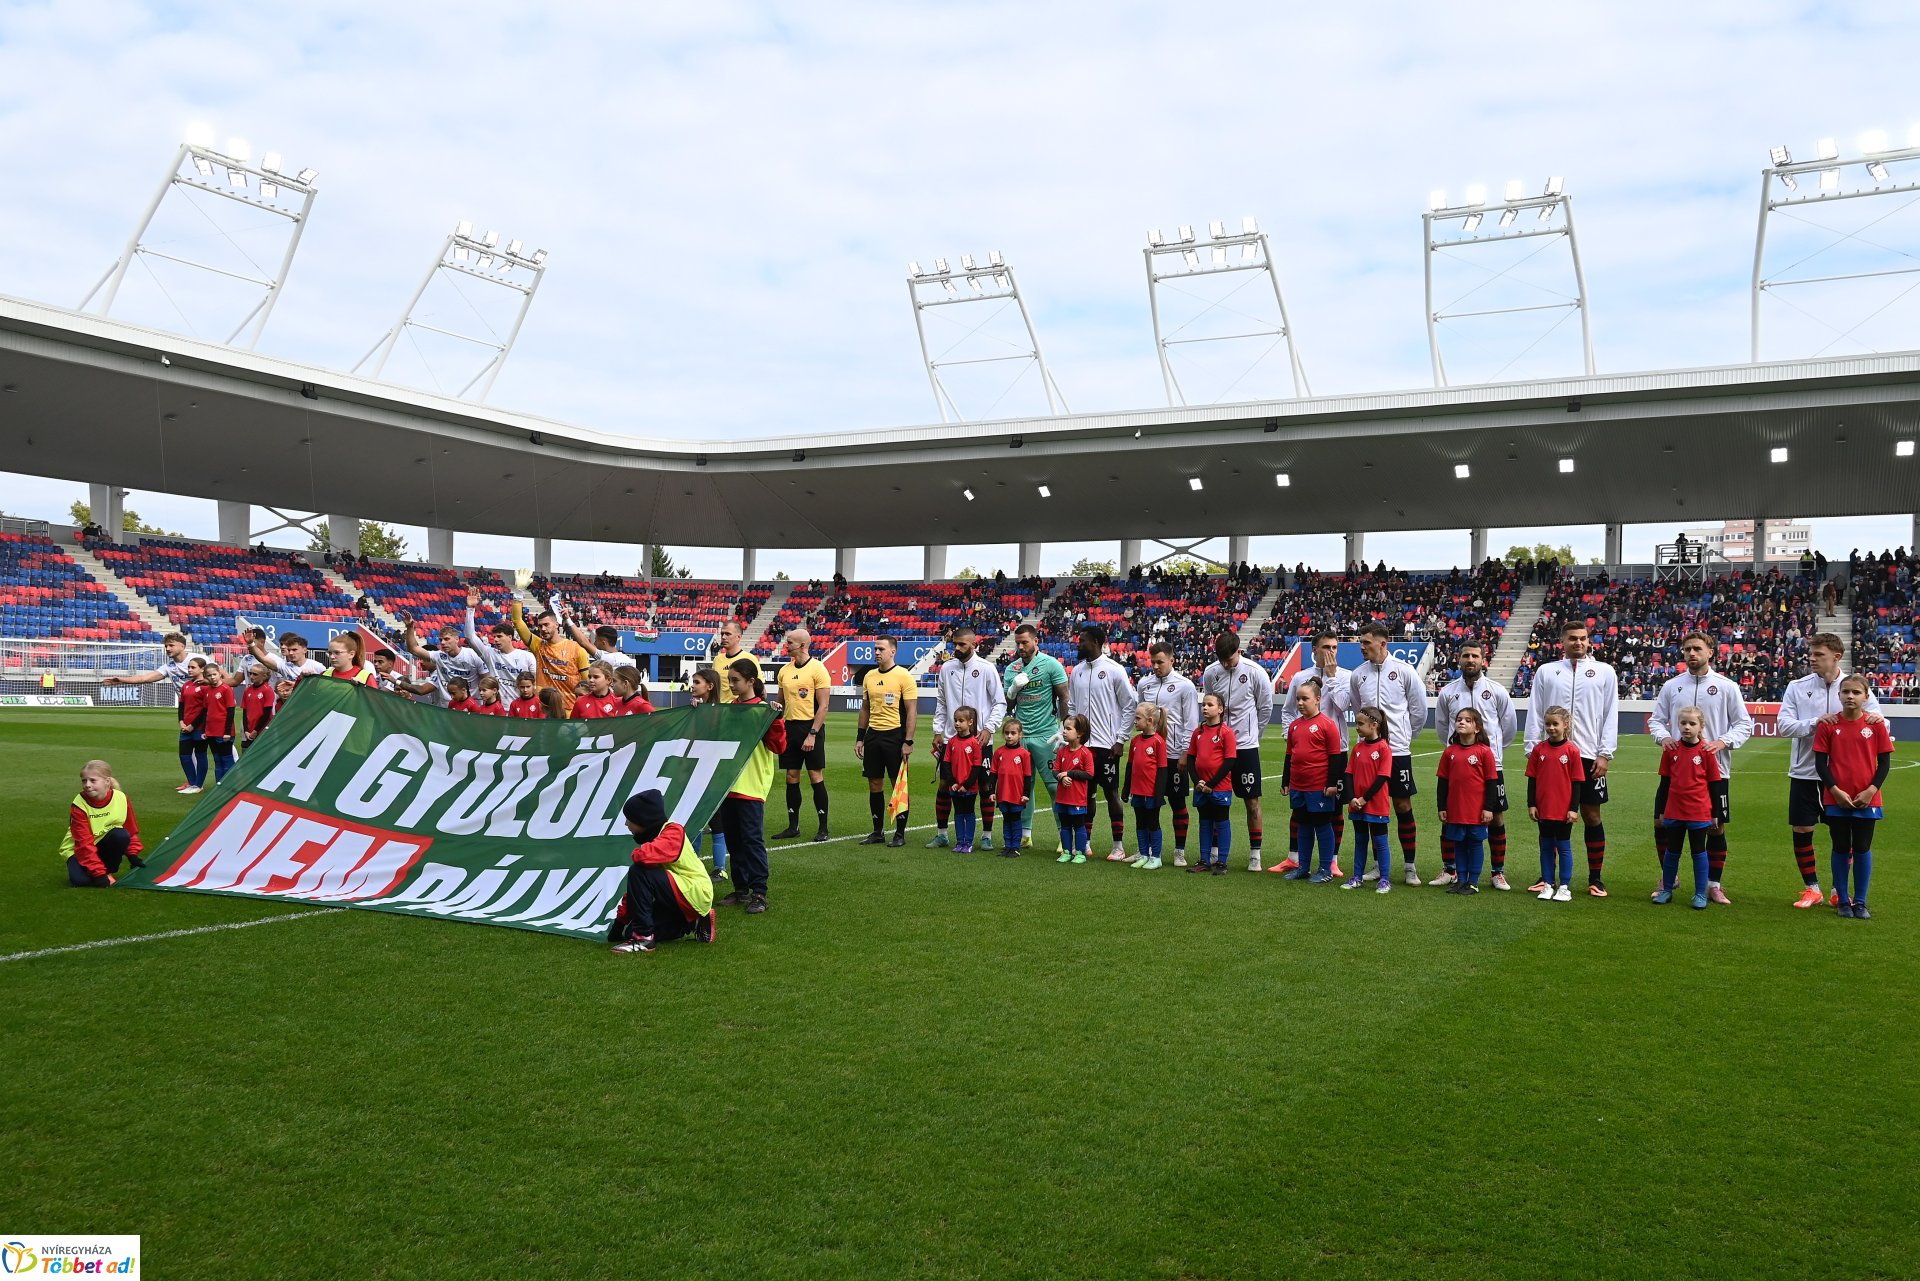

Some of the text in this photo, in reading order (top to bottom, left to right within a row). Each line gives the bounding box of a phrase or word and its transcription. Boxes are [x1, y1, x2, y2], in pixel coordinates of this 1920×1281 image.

[684, 637, 705, 651] C8
[854, 647, 872, 660] C8
[842, 666, 849, 683] 8
[100, 687, 140, 701] MARKE
[982, 757, 991, 769] 41
[1104, 763, 1116, 775] 34
[257, 710, 741, 840] A GYŰLÖLET
[1173, 773, 1180, 784] 6
[1241, 773, 1254, 785] 66
[1399, 769, 1410, 782] 31
[1594, 776, 1605, 790] 20
[1496, 784, 1504, 797] 18
[155, 799, 420, 901] NEM
